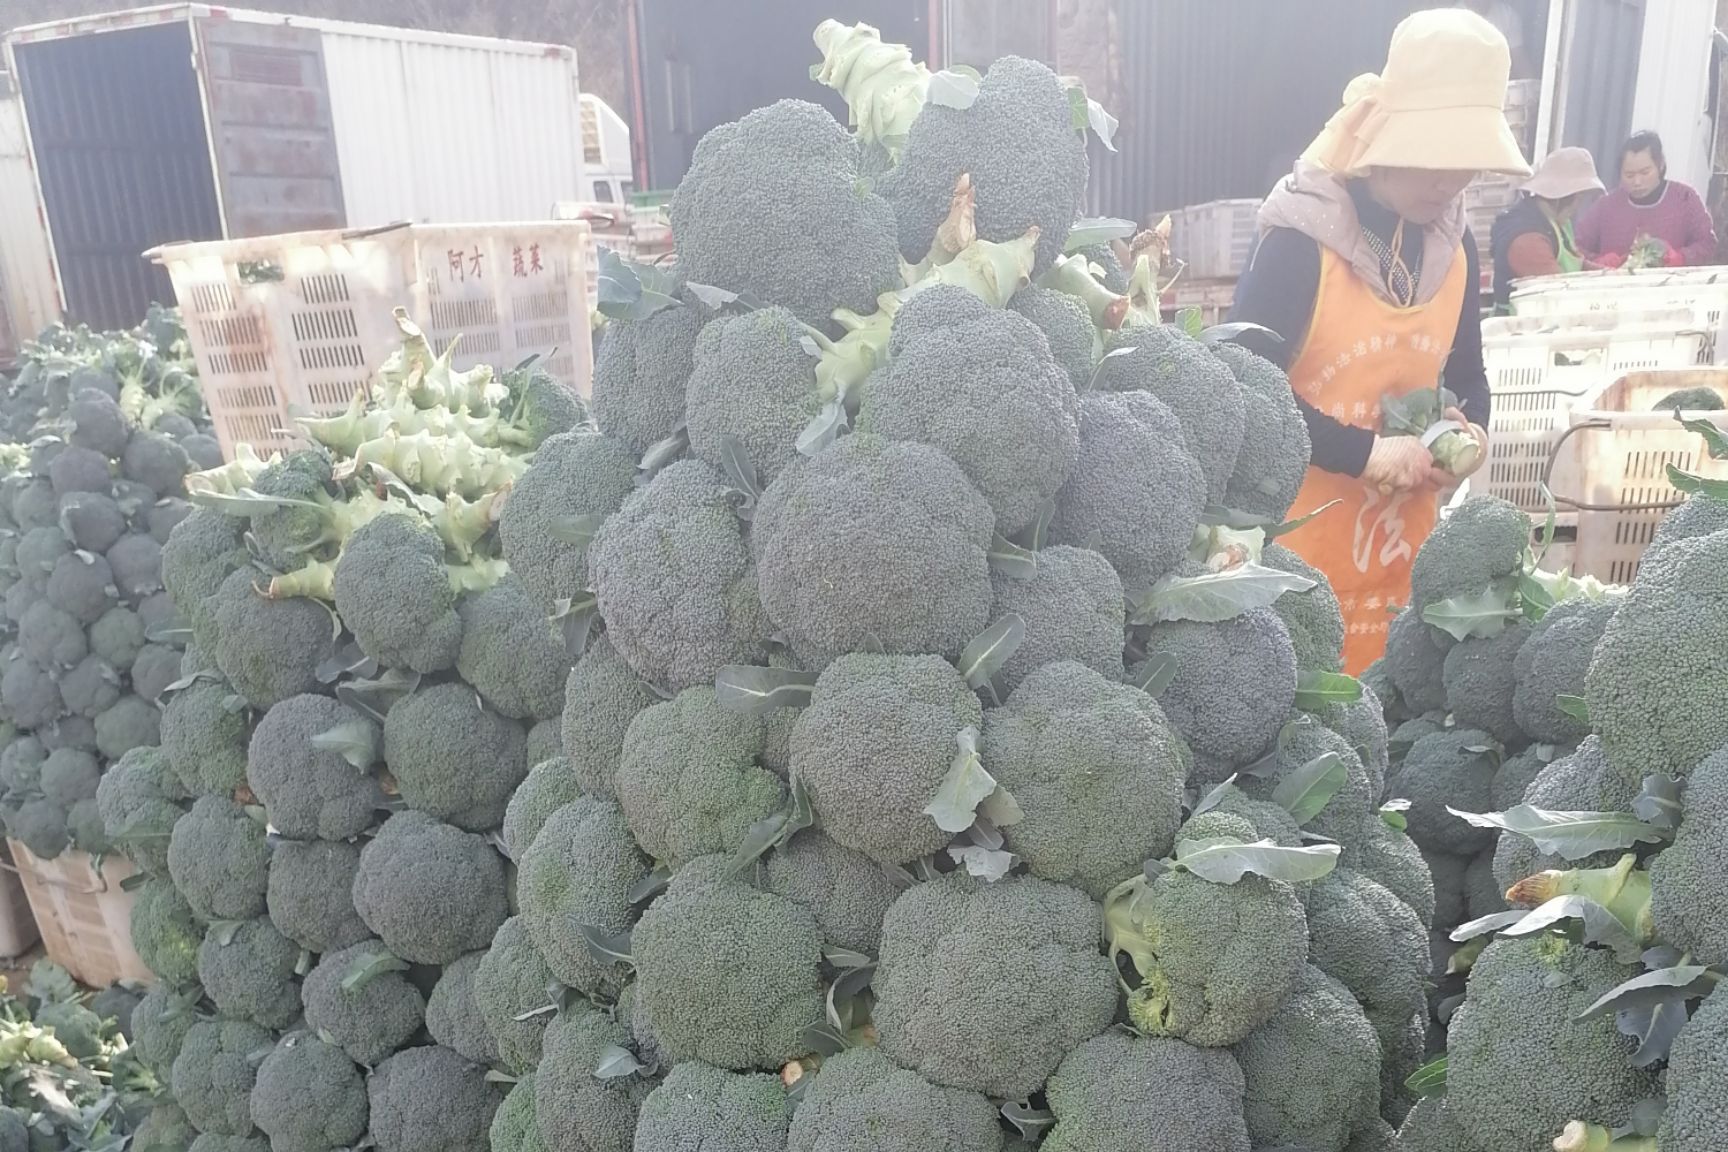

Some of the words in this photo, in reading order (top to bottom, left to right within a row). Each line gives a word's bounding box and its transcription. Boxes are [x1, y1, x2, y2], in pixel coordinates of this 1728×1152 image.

[447, 244, 484, 283] 阿才
[513, 242, 544, 278] 蔬菜
[1353, 486, 1411, 573] 法
